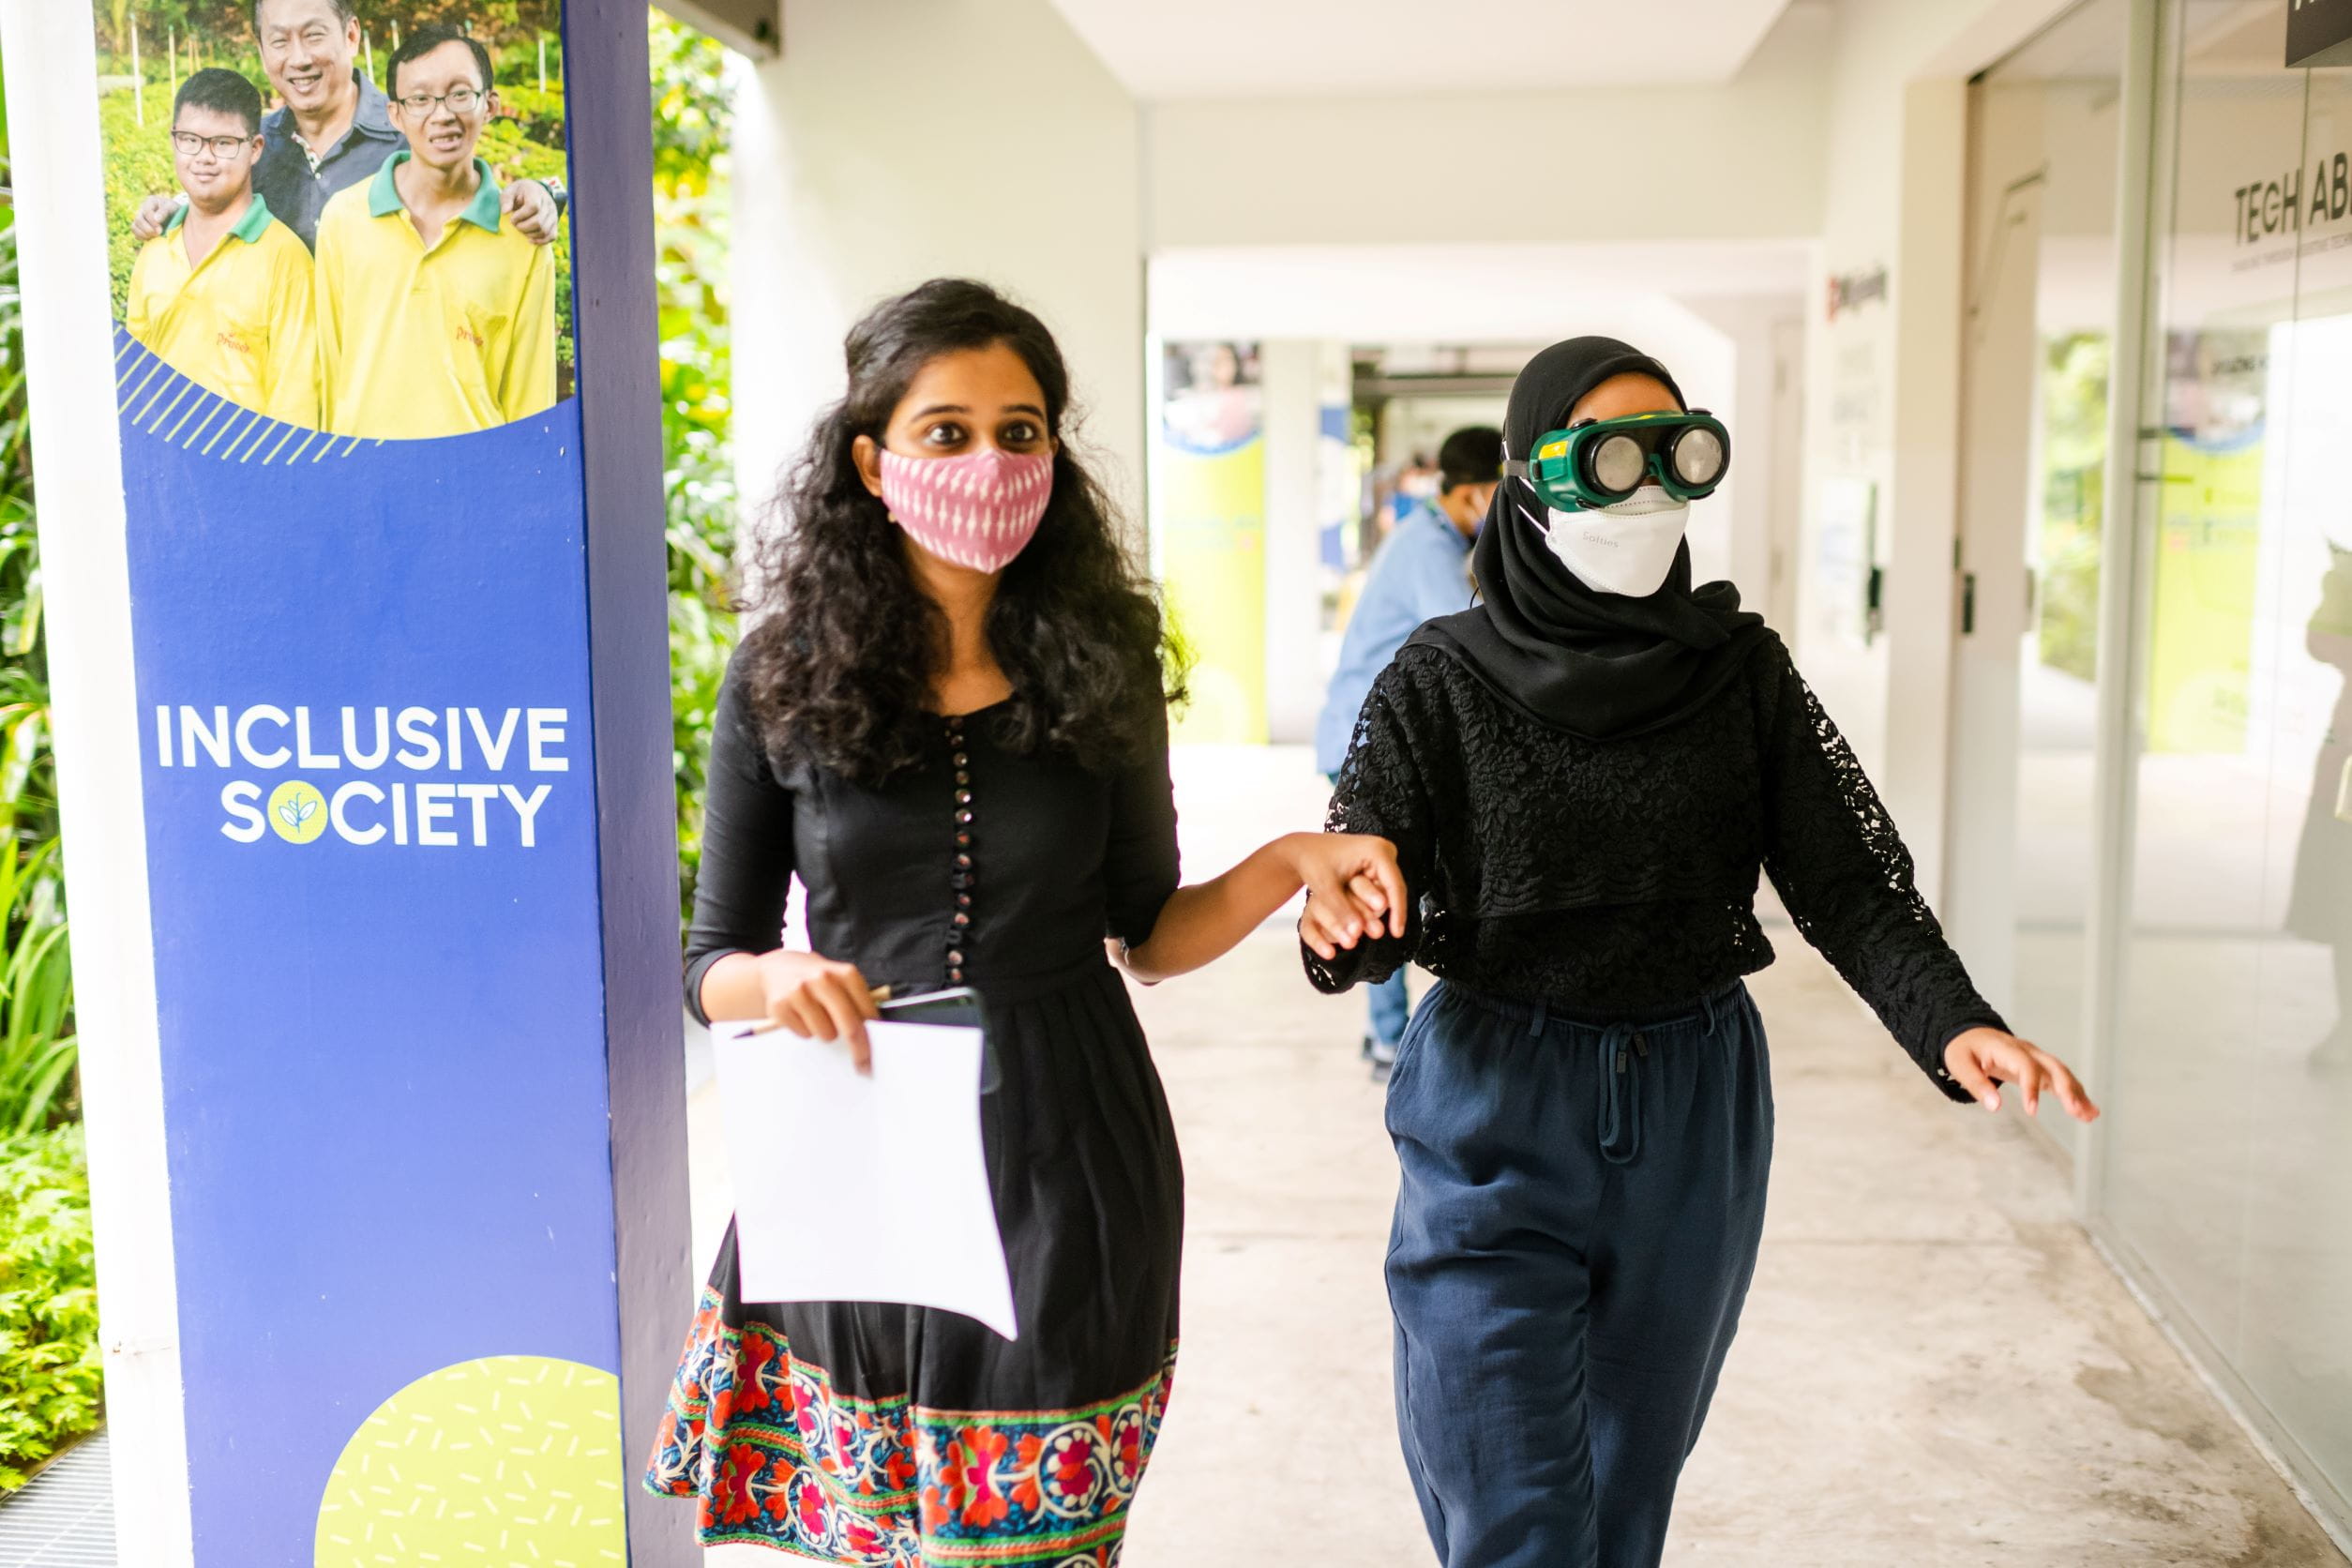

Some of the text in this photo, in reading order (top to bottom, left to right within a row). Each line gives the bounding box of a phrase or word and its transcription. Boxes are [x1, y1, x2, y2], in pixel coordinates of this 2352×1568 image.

[2309, 151, 2352, 226] AB
[156, 703, 569, 772] INCLUSIVE
[219, 779, 553, 848] SOCIETY
